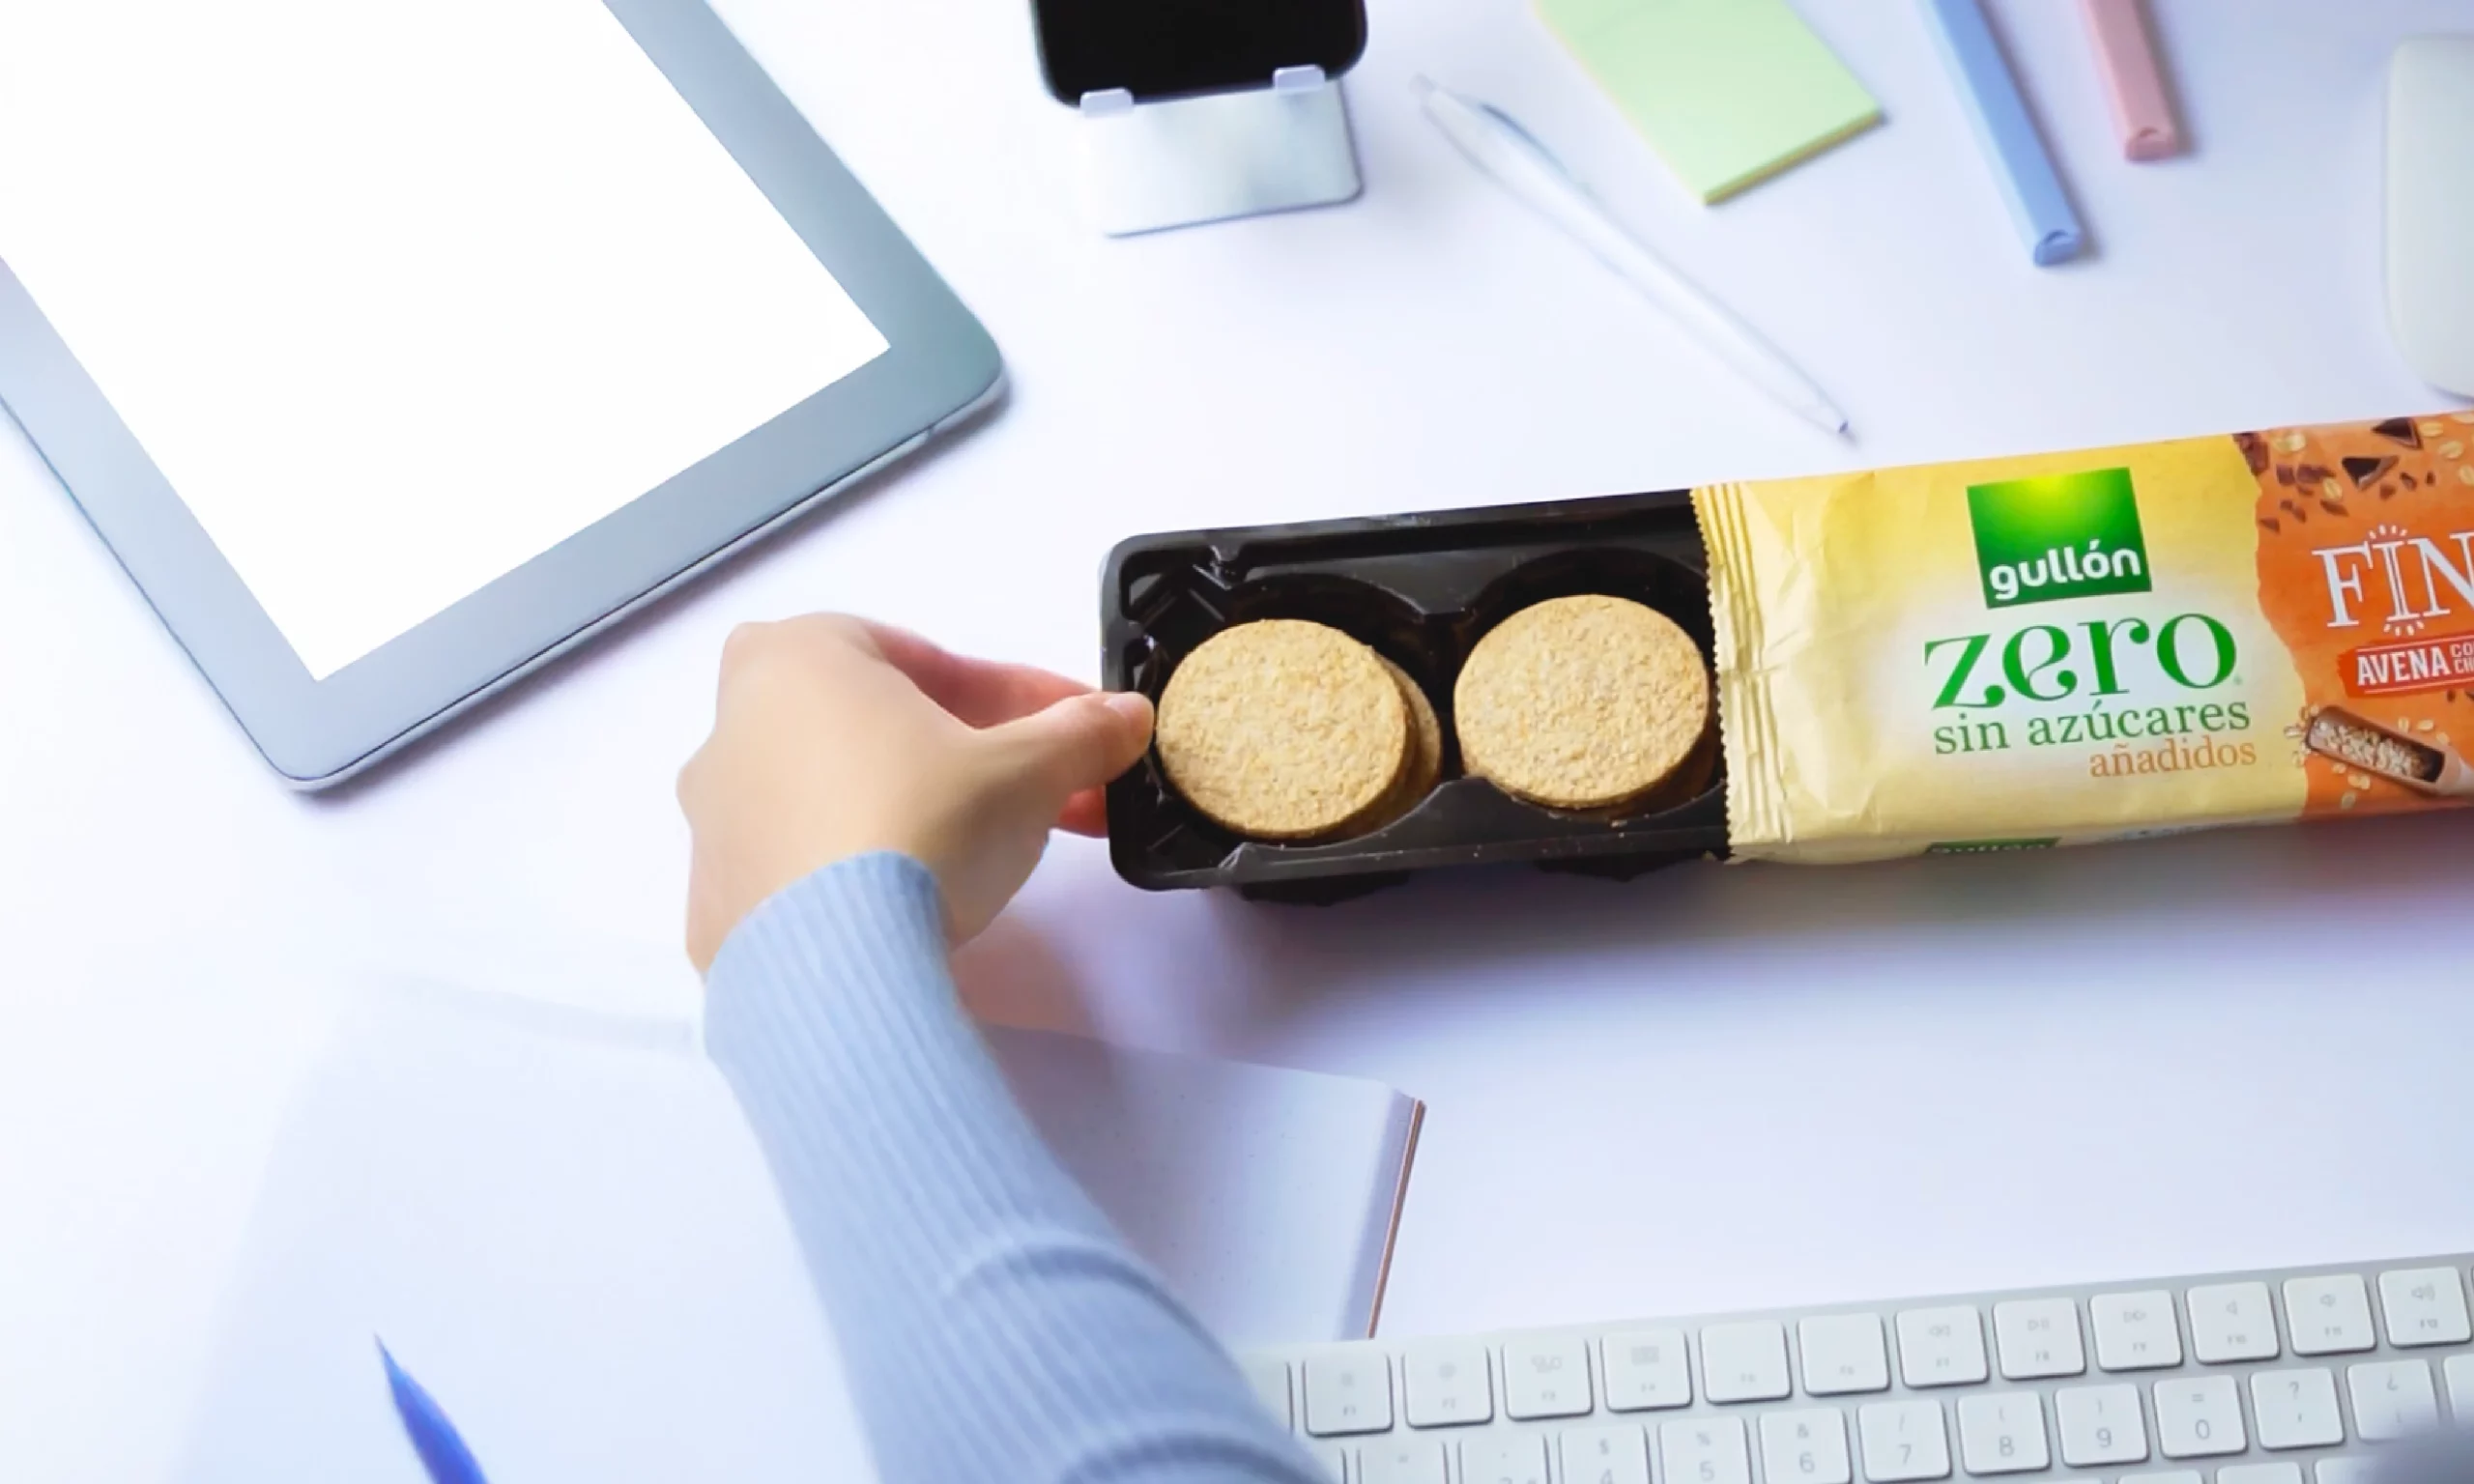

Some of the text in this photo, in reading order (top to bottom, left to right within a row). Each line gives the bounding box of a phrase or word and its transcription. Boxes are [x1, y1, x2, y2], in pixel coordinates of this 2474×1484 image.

[1989, 539, 2141, 600] gullón
[2312, 531, 2474, 627] FIN
[1924, 613, 2236, 710] zero
[2357, 645, 2452, 686] AVENA
[1934, 699, 2251, 755] sin azúcares
[2089, 735, 2257, 778] añadidos
[1898, 1442, 1913, 1466] 7
[1999, 1435, 2015, 1456] 8
[2095, 1426, 2113, 1447] 9
[1699, 1460, 1715, 1482] 5
[1798, 1451, 1816, 1474] 6
